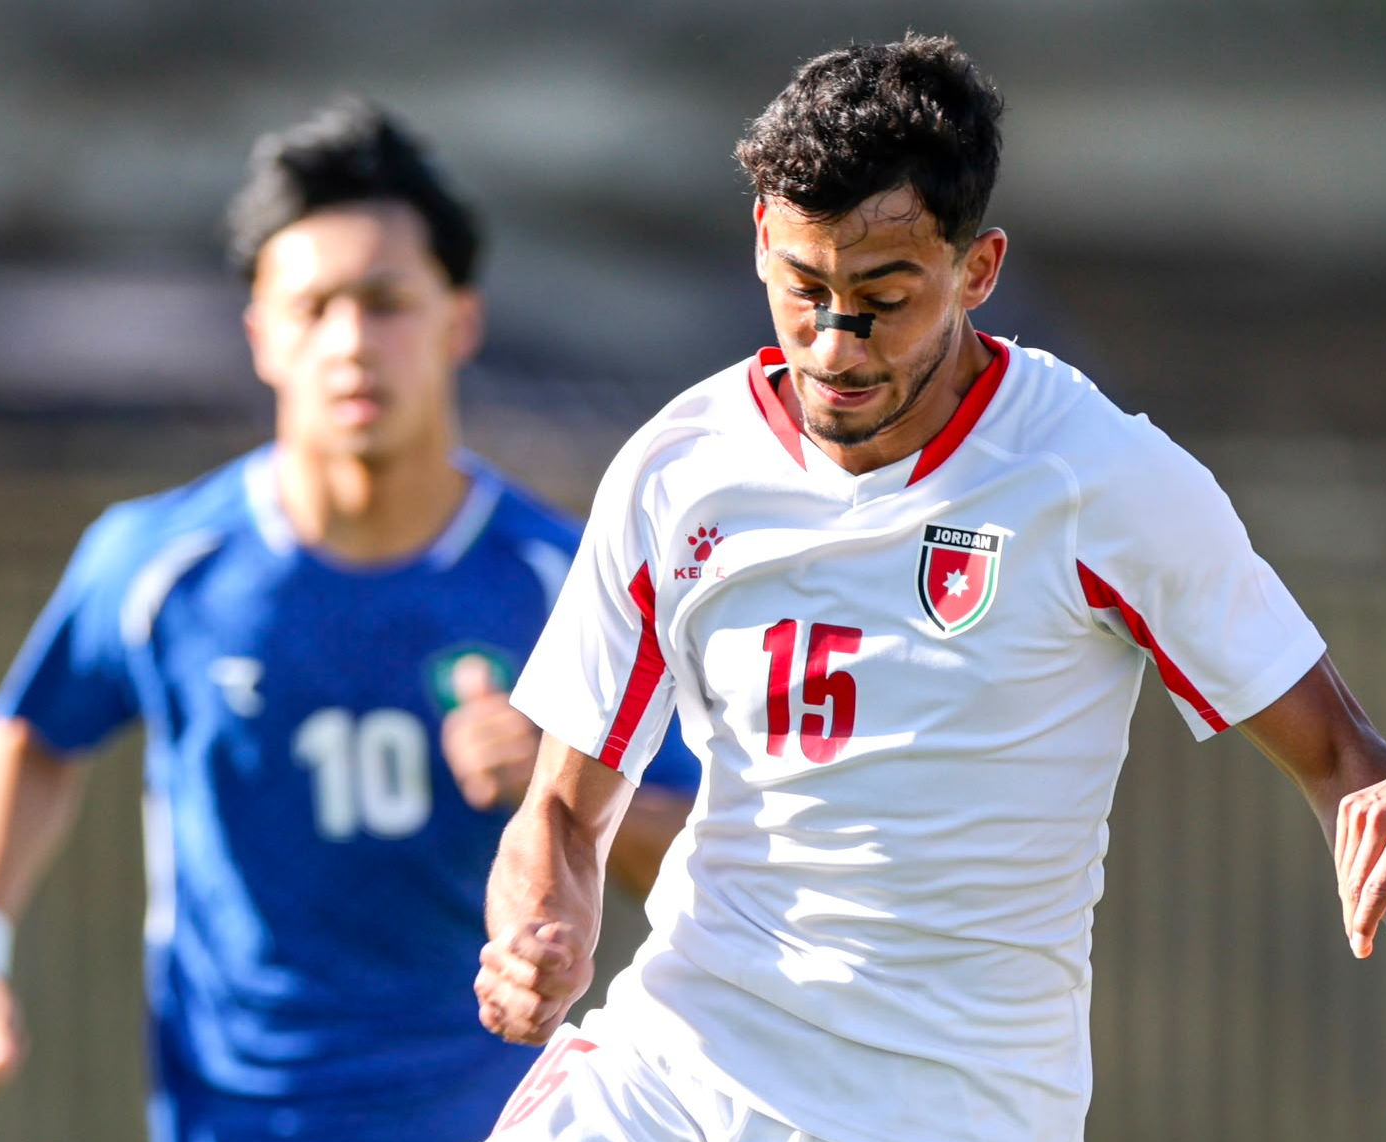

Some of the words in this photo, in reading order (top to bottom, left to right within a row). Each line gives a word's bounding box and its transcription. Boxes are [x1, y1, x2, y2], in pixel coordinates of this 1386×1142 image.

[674, 566, 726, 580] KELE
[933, 528, 992, 550] JORDAN
[763, 618, 863, 764] 15
[293, 706, 430, 842] 10
[491, 1038, 599, 1136] 15
